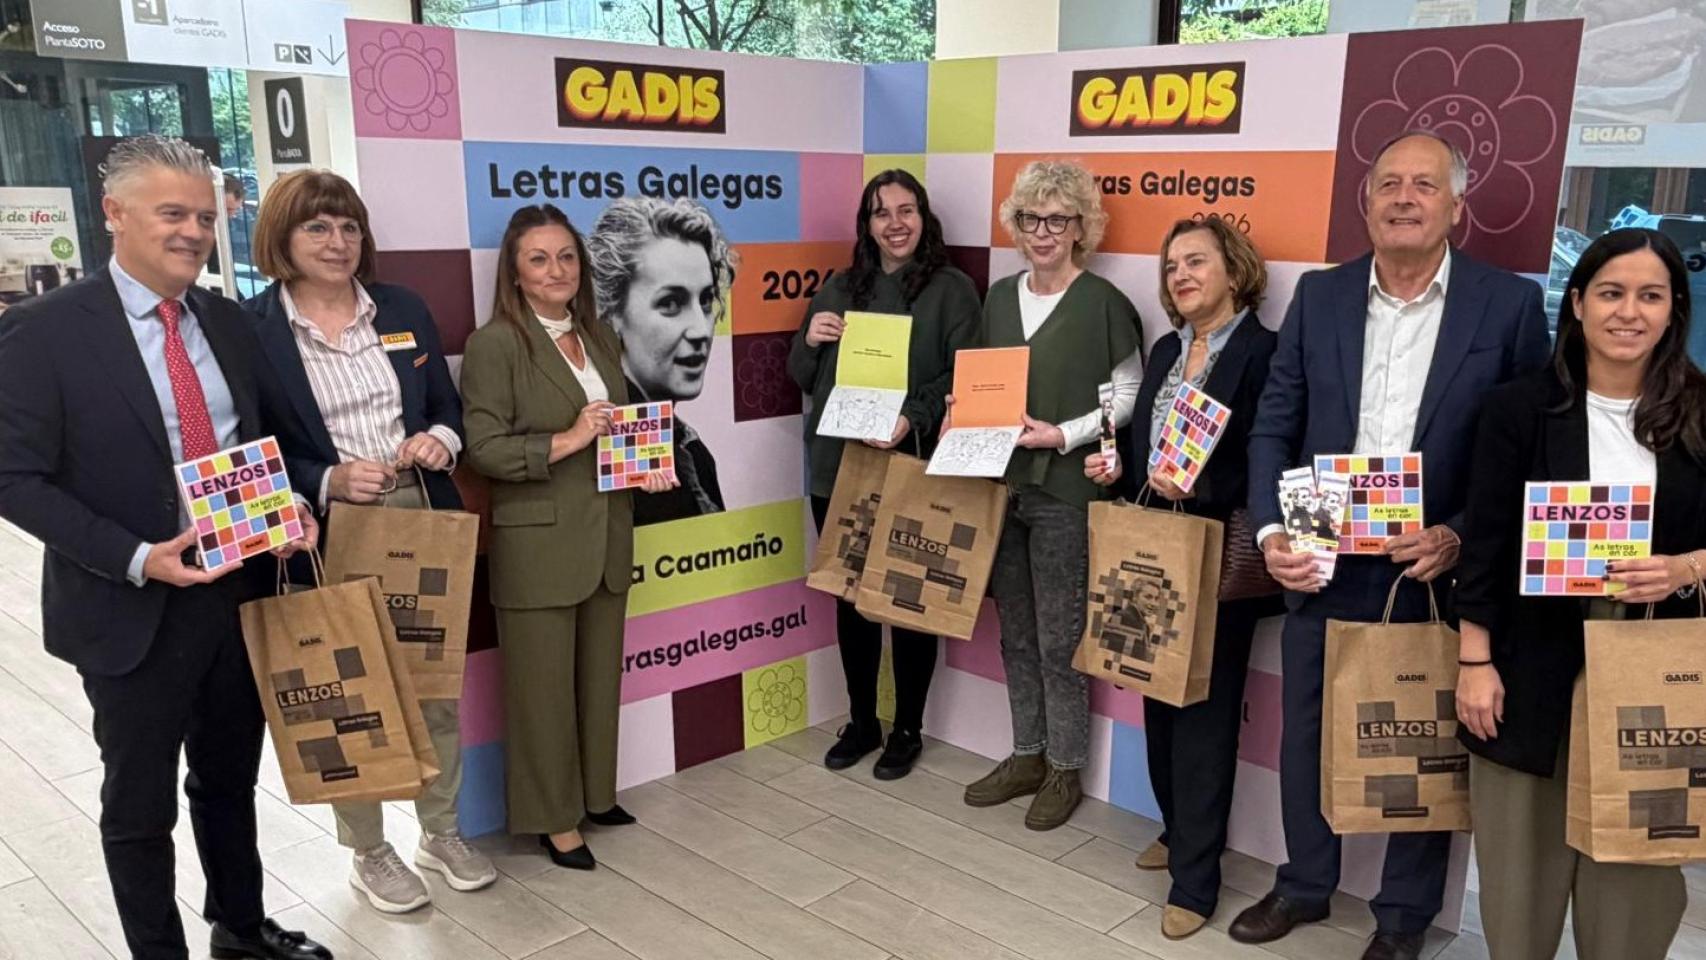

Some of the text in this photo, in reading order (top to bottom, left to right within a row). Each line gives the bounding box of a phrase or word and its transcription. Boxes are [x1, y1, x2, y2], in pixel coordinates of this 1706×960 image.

[43, 22, 80, 33] Acceso
[44, 36, 105, 50] PlantaSOTO
[563, 66, 721, 123] GADIS
[1077, 70, 1238, 129] GADIS
[488, 162, 784, 209] Letras Galegas
[1092, 169, 1256, 204] ras Galegas
[6, 211, 27, 223] de
[610, 419, 659, 435] ENZOS
[1173, 399, 1211, 432] LENZOS
[189, 463, 267, 499] LENZOS
[1350, 474, 1400, 488] NZOS
[1532, 505, 1627, 520] LENZOS
[654, 532, 784, 578] Caamaño
[890, 531, 948, 556] LENZOS
[1607, 543, 1635, 551] letras
[621, 604, 808, 673] rasgalegas.gal
[1665, 673, 1700, 682] GADIS
[278, 683, 344, 707] LENZOS
[1359, 722, 1437, 738] LENZOS
